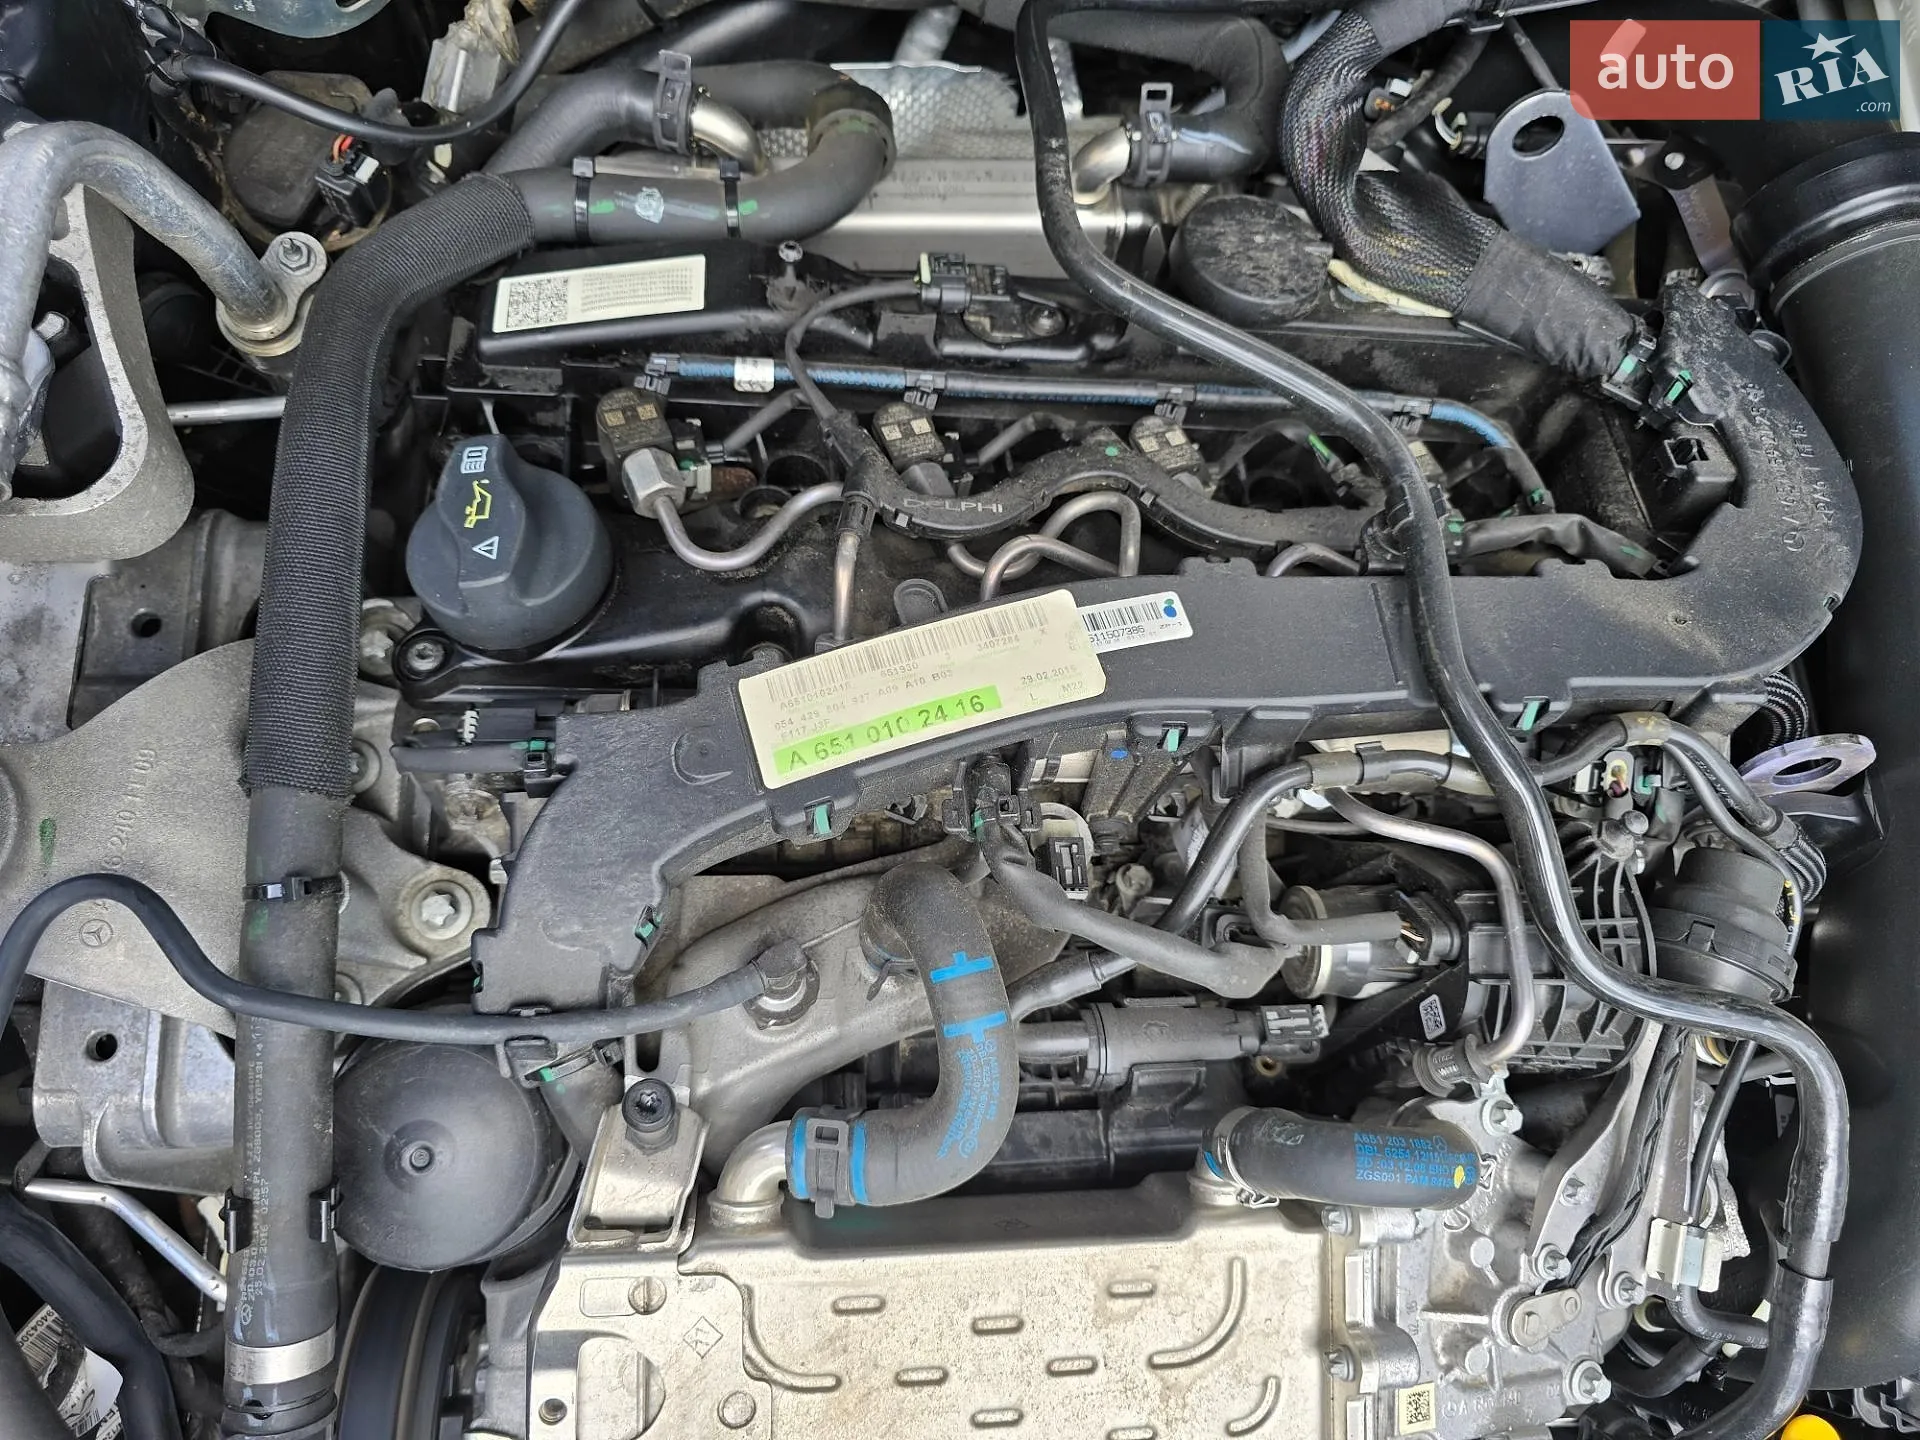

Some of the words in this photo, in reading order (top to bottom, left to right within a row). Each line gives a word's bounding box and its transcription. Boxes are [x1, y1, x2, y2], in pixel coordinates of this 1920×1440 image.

[903, 498, 1004, 513] DELPHI
[790, 750, 808, 771] A
[814, 733, 854, 760] 651
[866, 716, 911, 744] 010
[918, 704, 948, 728] 24
[956, 694, 985, 716] 16
[1356, 1169, 1401, 1183] ZGS001
[259, 1178, 269, 1214] 02:57
